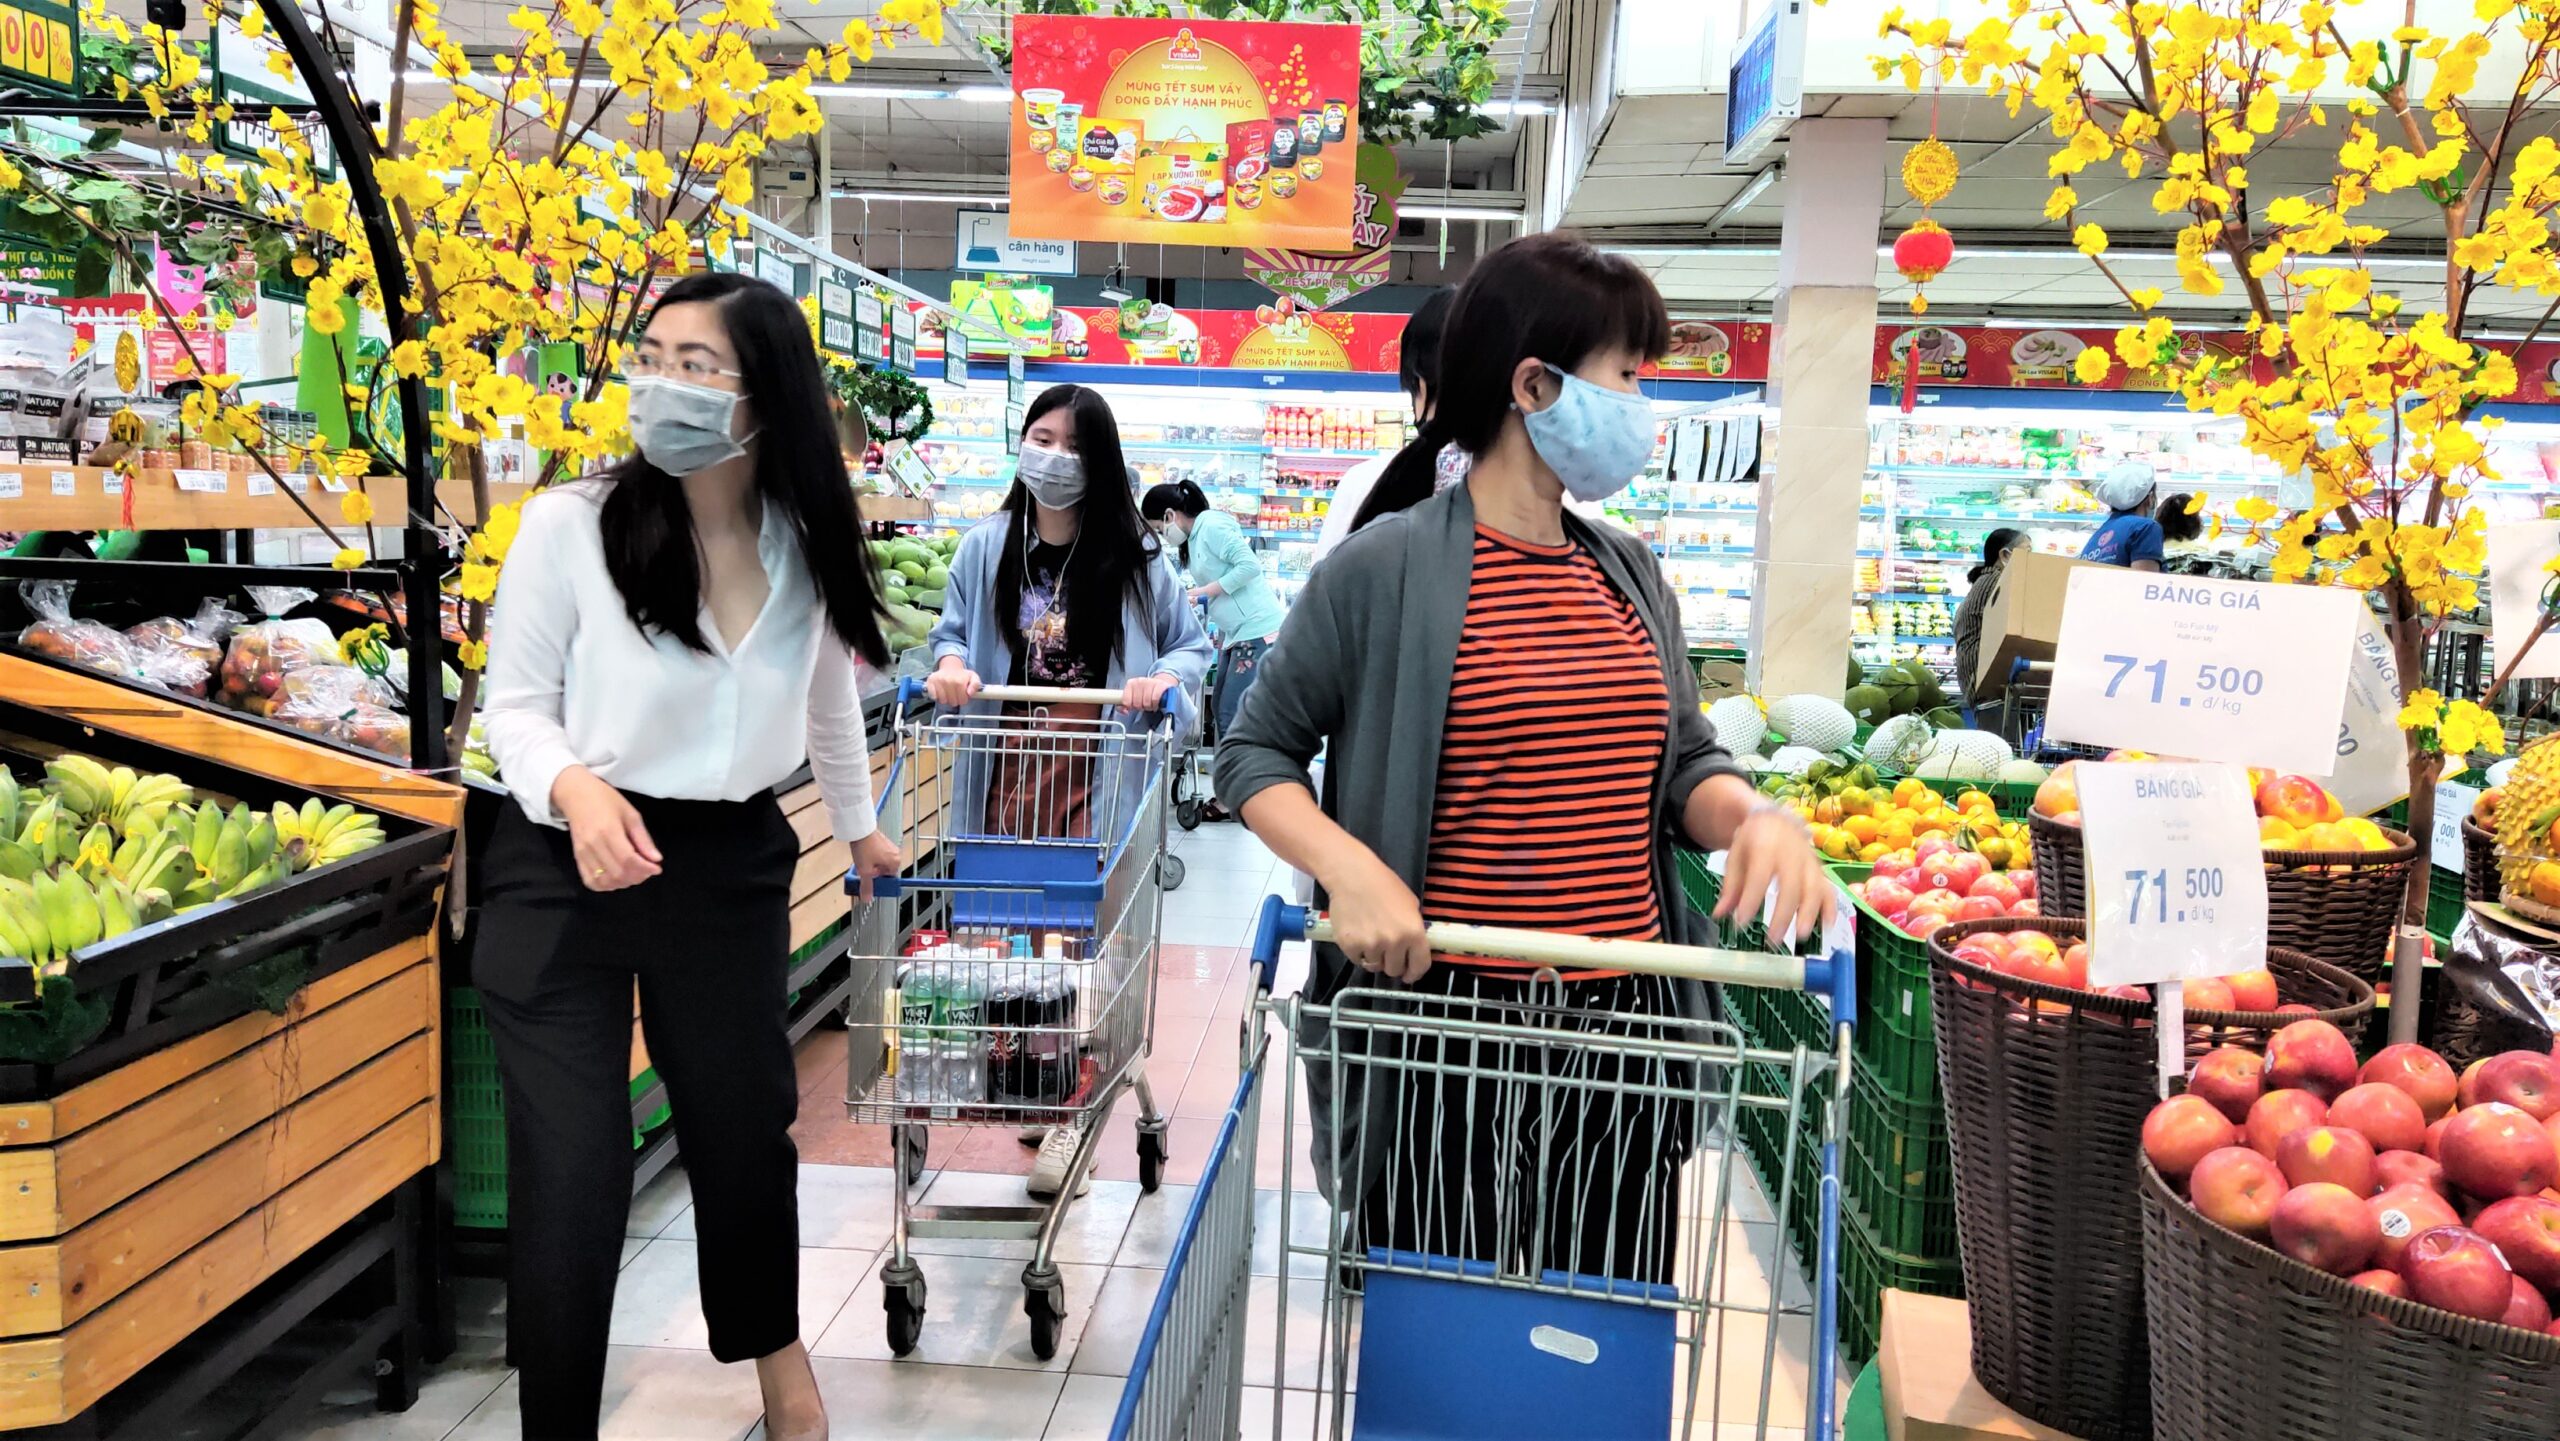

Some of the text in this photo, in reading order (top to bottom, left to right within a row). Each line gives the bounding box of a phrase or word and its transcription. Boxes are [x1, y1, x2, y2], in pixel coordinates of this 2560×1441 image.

[1165, 80, 1187, 93] TẾT
[1190, 83, 1215, 94] SUM
[1183, 97, 1217, 110] HẠNH
[1220, 97, 1252, 109] PHÚC
[1008, 241, 1064, 255] cân hàng
[1285, 277, 1349, 289] BEST PRICE
[1296, 348, 1316, 357] SUM
[1320, 358, 1345, 368] PHÚC
[2129, 379, 2160, 387] ĐONG
[26, 395, 60, 408] NATURAL
[41, 441, 71, 453] NATURAL
[2144, 581, 2261, 611] BẢNG GIÁ
[2358, 632, 2397, 682] BẢNG
[2135, 774, 2179, 799] BẢNG
